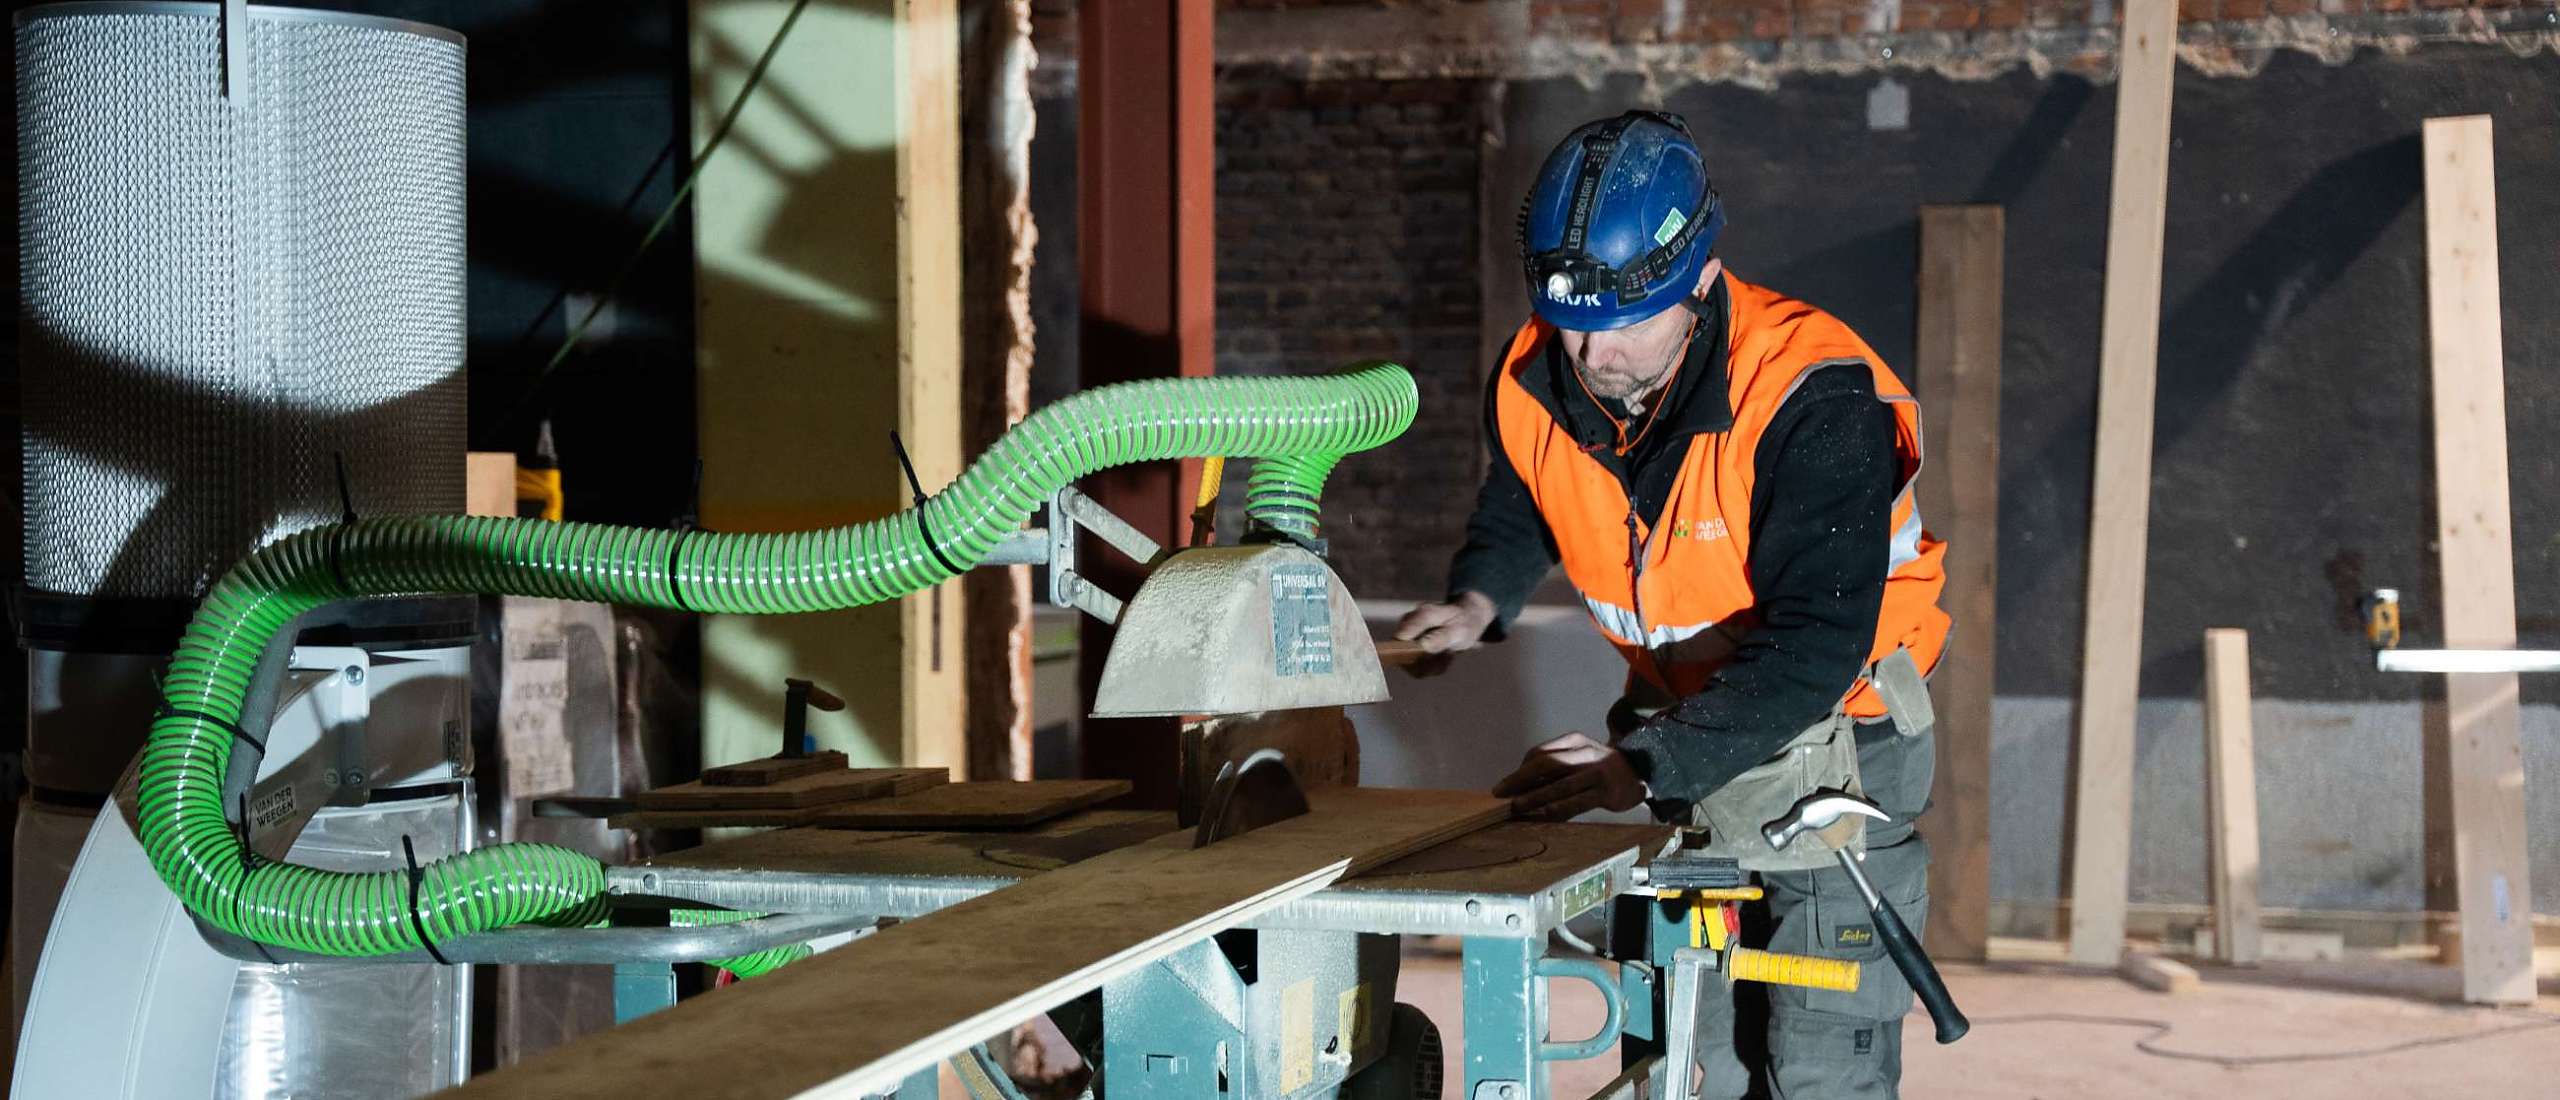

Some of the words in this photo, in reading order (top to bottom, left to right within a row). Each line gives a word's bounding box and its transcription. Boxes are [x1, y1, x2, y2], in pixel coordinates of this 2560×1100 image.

[1573, 176, 1595, 226] HEADLIGHT
[1568, 228, 1582, 250] LED
[1665, 236, 1686, 261] LED
[1282, 574, 1317, 588] UNIVERSAL
[255, 795, 273, 813] VAN
[274, 786, 292, 804] DER
[256, 797, 294, 827] WEEGEN
